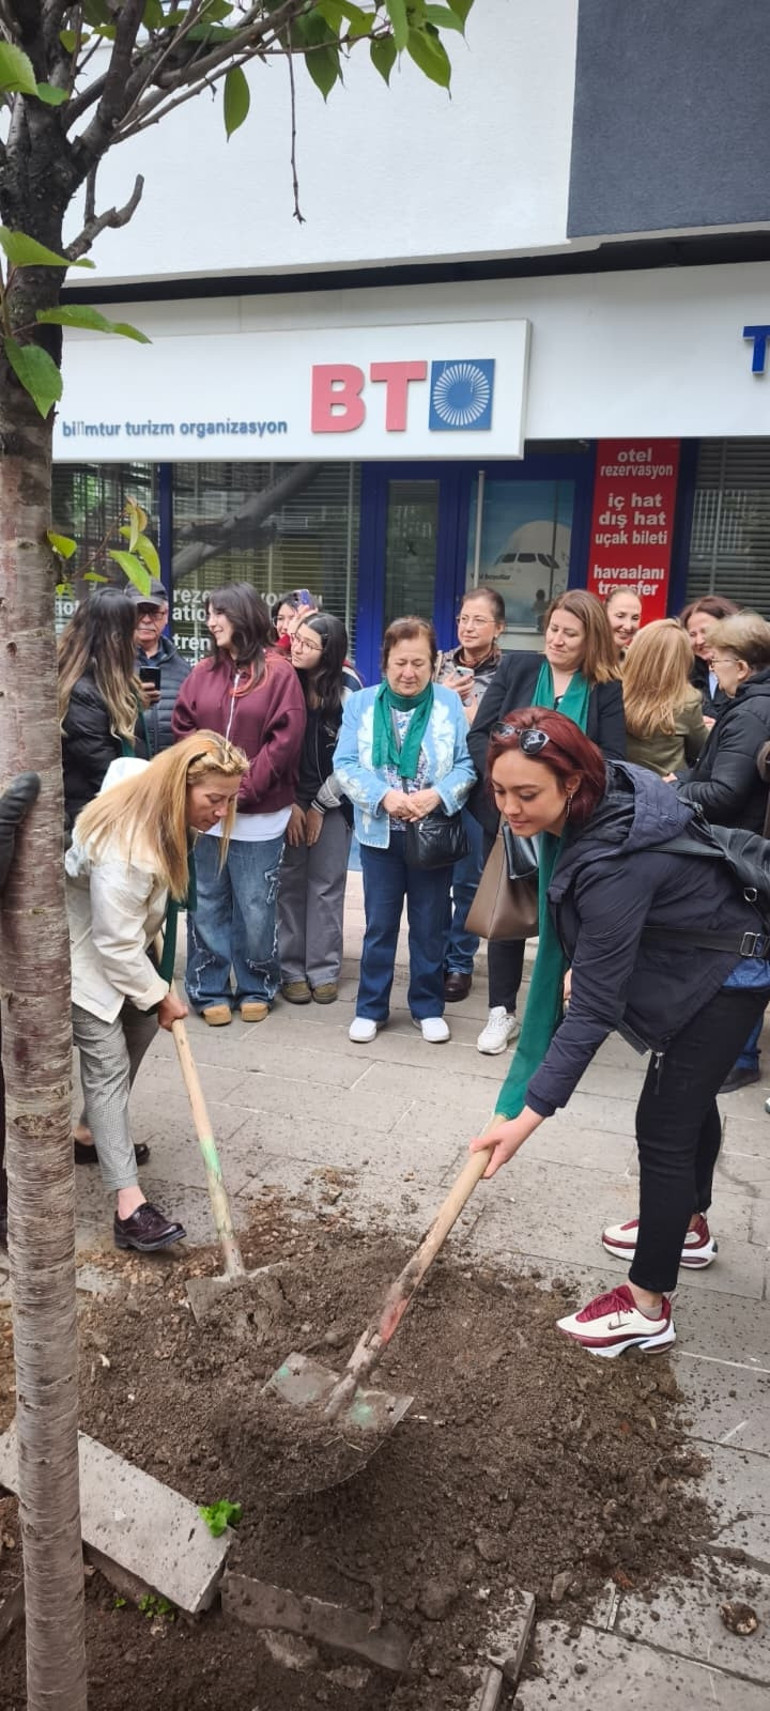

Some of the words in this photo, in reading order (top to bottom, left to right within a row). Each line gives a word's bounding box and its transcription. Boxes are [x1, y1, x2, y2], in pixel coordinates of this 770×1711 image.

[125, 419, 174, 436] turizm
[180, 417, 288, 439] organizasyon
[617, 447, 652, 462] otel
[600, 465, 673, 480] rezervasyon
[607, 492, 625, 511] iç
[631, 492, 662, 507] hat
[598, 511, 628, 529] dış
[634, 511, 666, 526] hat
[595, 530, 628, 548] uçak
[632, 530, 668, 544] bileti
[593, 564, 665, 579] havaalanı
